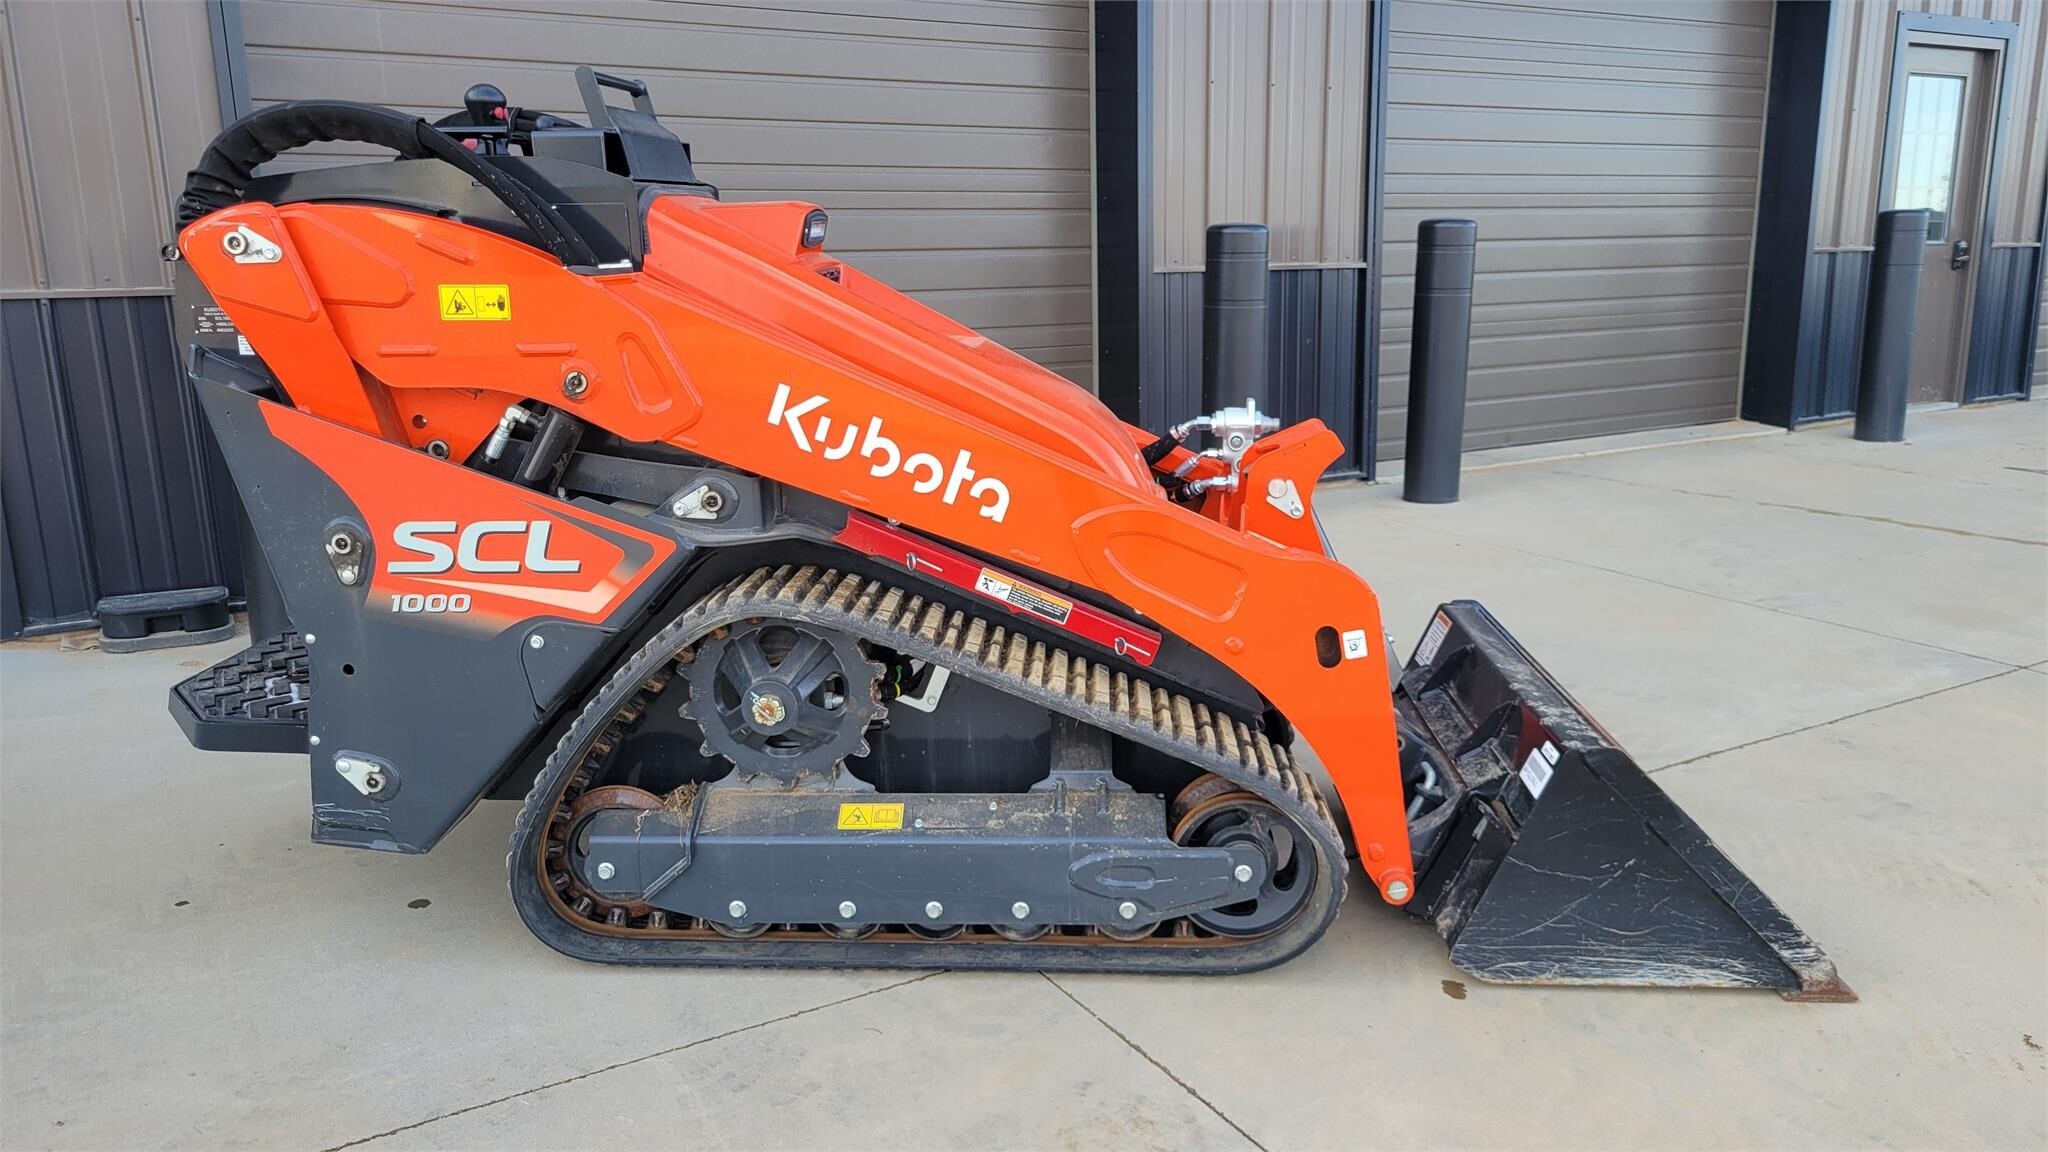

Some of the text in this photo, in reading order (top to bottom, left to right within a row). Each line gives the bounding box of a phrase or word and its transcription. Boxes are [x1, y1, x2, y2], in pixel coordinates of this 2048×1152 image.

[767, 383, 1010, 523] Kubota
[387, 521, 582, 573] SCL
[391, 594, 472, 613] 1000
